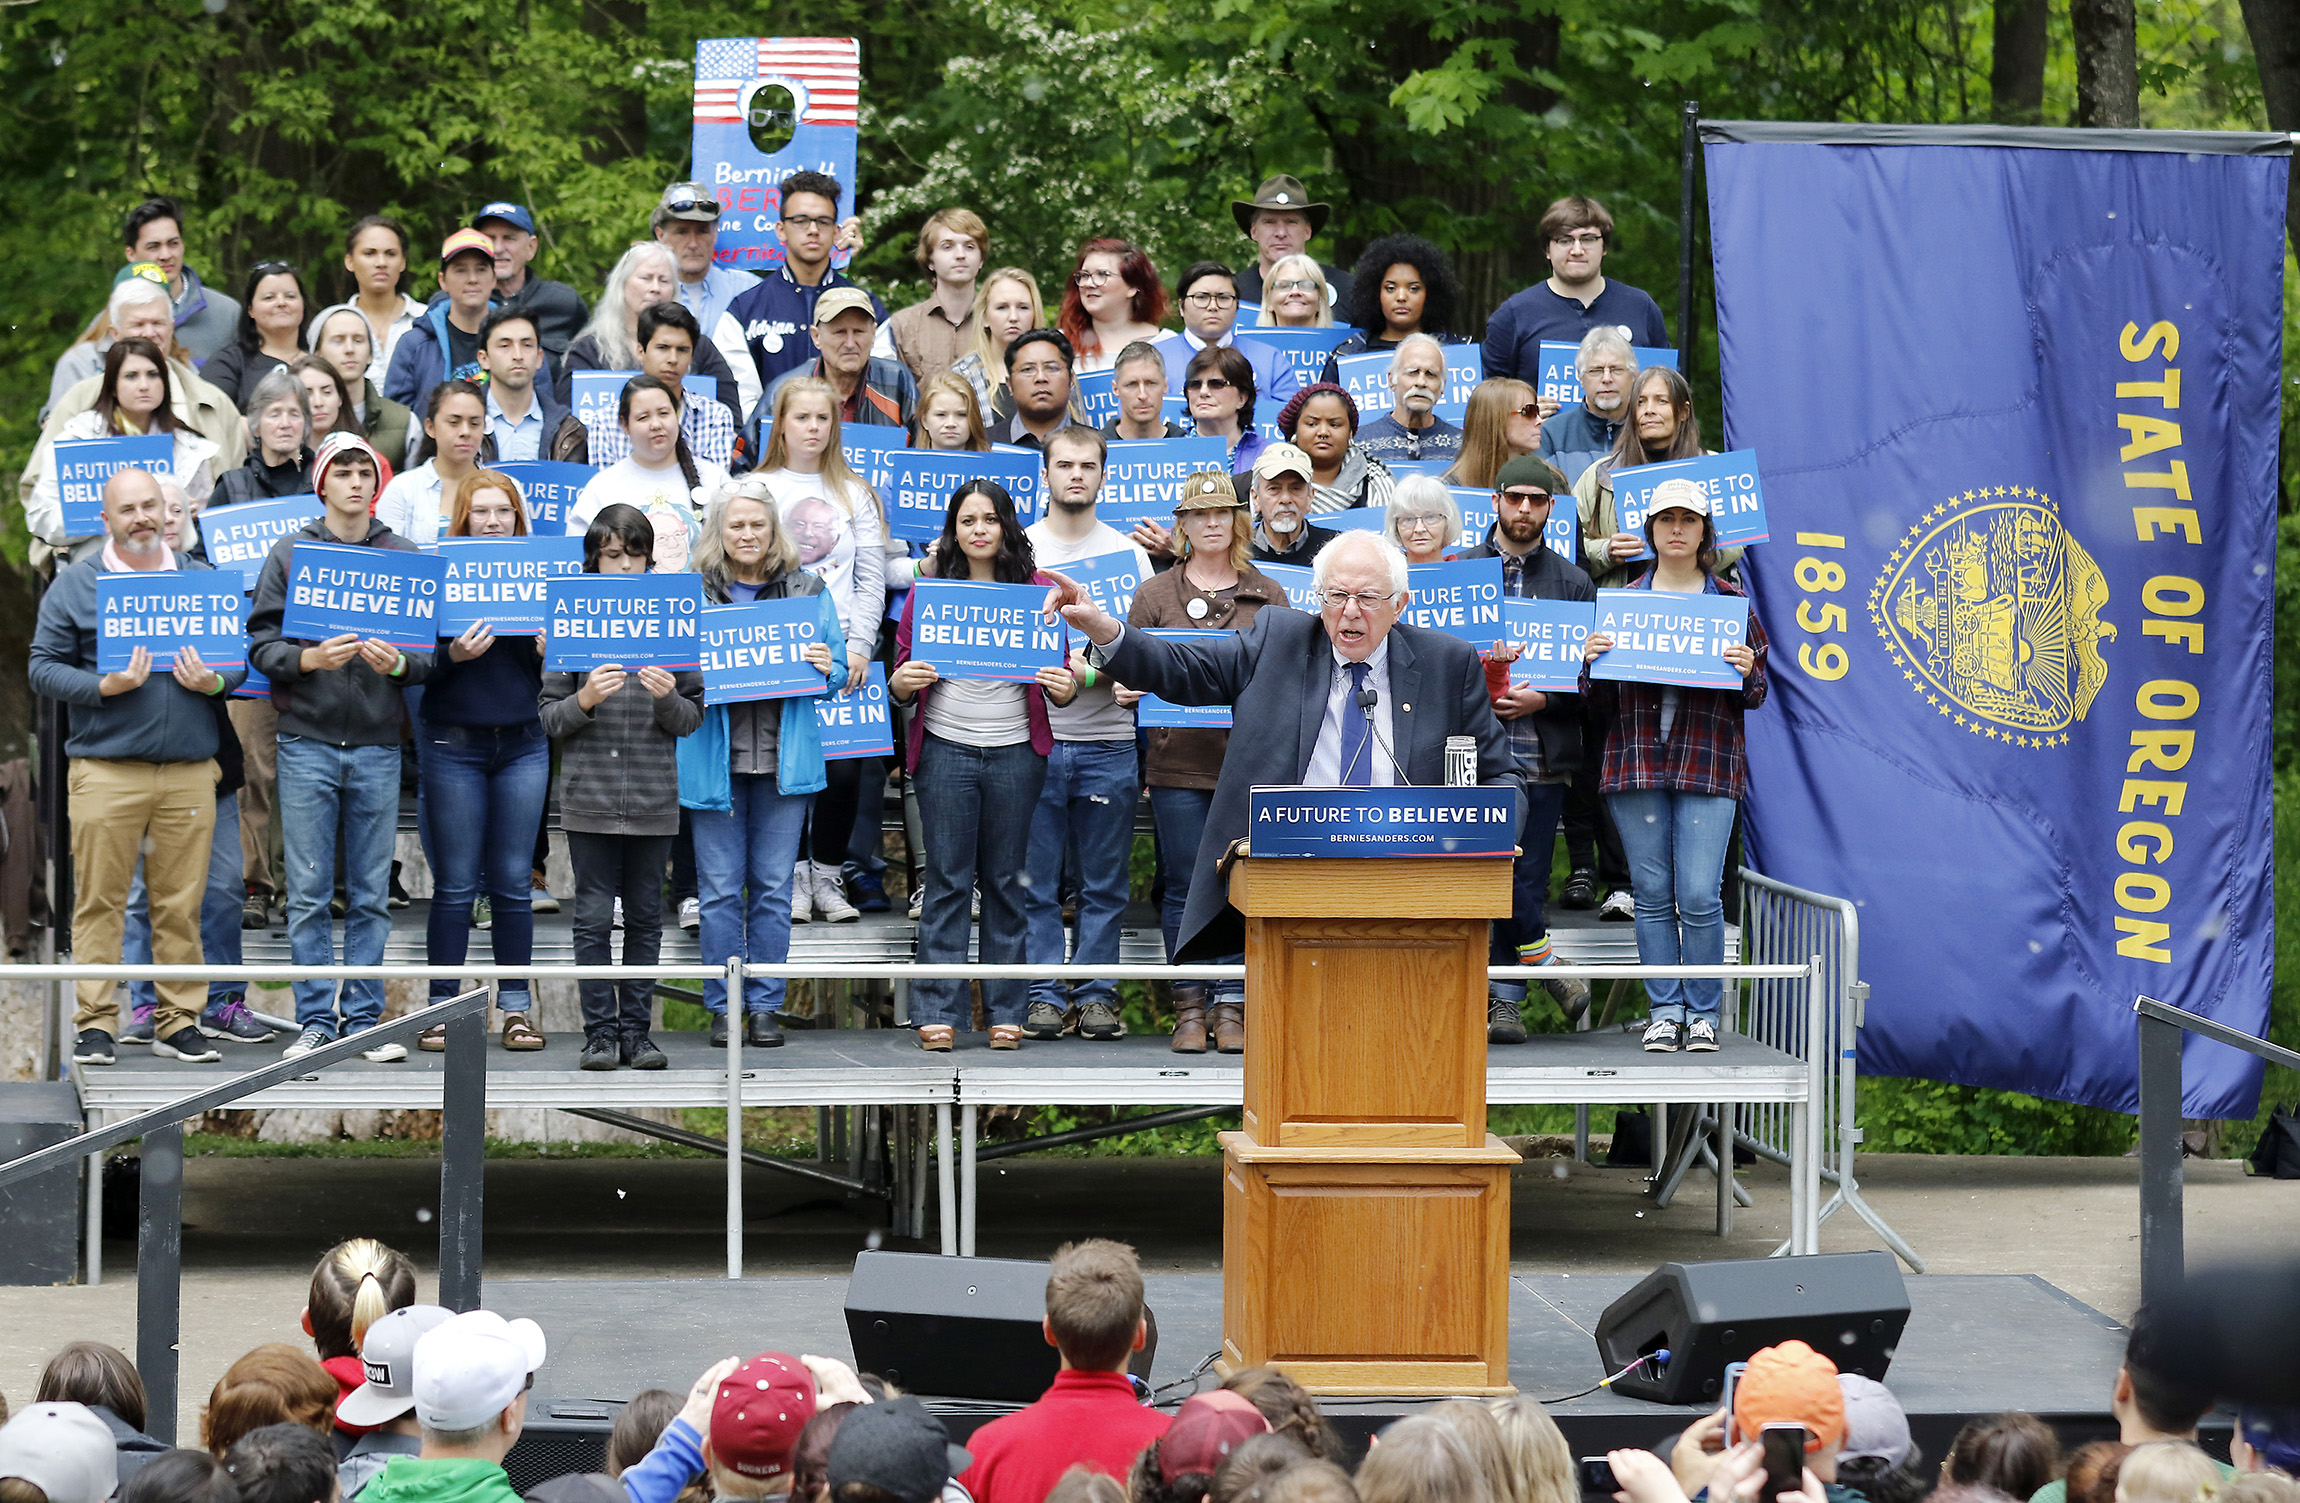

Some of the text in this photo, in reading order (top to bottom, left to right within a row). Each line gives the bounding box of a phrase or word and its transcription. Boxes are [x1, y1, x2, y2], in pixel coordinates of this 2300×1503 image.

[745, 319, 797, 341] Adrian
[1348, 377, 1361, 392] A
[1448, 366, 1476, 383] TO
[1546, 364, 1558, 380] A
[579, 392, 594, 406] A
[62, 464, 74, 480] A
[142, 458, 170, 475] TO
[1107, 462, 1188, 481] FUTURE
[900, 470, 914, 487] A
[1004, 476, 1034, 492] TO
[1623, 491, 1638, 508] A
[1724, 473, 1755, 492] TO
[1731, 492, 1759, 514] IN
[213, 528, 228, 544] A
[1547, 519, 1571, 536] TO
[445, 560, 584, 579] A FUTURE TO
[297, 565, 438, 596] A FUTURE TO
[1106, 573, 1136, 593] TO
[445, 582, 548, 602] BELIEVE
[1409, 583, 1498, 606] TURE TO
[105, 594, 239, 614] A FUTURE TO
[294, 586, 435, 620] BELIEVE IN
[554, 597, 696, 616] A FUTURE TO
[1793, 531, 1850, 682] 1859
[921, 603, 936, 621] A
[941, 604, 1025, 626] FUTURE
[1407, 604, 1500, 628] IEVE IN
[1602, 612, 1741, 636] A FUTURE TO
[1938, 580, 1948, 648] THE UNION
[104, 615, 240, 638] BELIEVE IN
[328, 624, 391, 636] BERNIESANDERS.COM
[553, 618, 696, 639] BELIEVE IN
[784, 621, 814, 640] TO
[1558, 624, 1588, 642] TO
[919, 624, 1025, 649] BELIEVE
[1032, 630, 1060, 651] IN
[1603, 630, 1706, 657] BELIEVE
[2113, 320, 2205, 964] STATE OF OREGON
[700, 645, 784, 672] ELIEVE
[956, 660, 1018, 669] BERNIESANDERS.COM
[1636, 664, 1698, 675] BERNIESANDERS.COM
[719, 680, 780, 690] BERNIESANDERS.COM
[859, 704, 886, 724] IN
[1258, 806, 1508, 824] A FUTURE TO BELIEVE IN
[1330, 834, 1435, 843] BERNIESANDERS.COM
